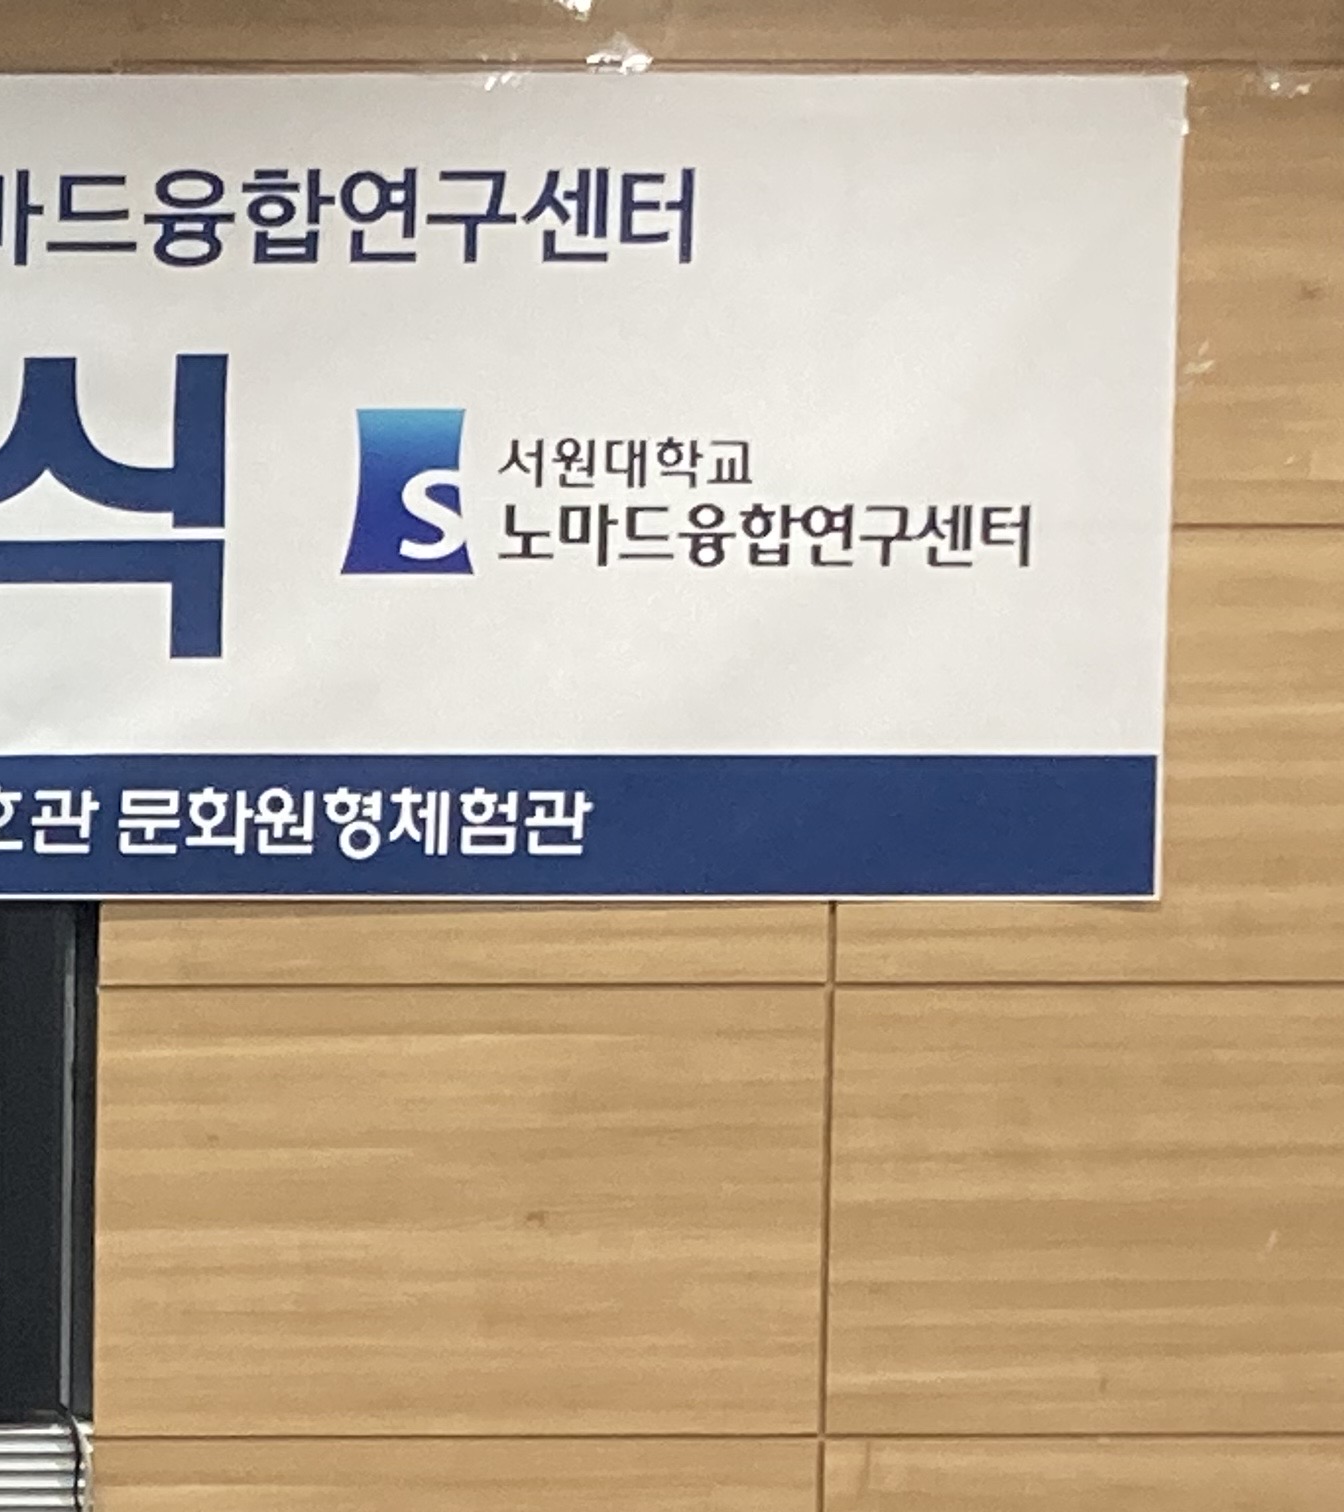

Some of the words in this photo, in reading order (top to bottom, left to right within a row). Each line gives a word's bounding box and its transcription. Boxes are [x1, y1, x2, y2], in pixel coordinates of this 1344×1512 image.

[498, 437, 753, 489] 서원대학교
[498, 503, 1032, 568] 노마드융합연구센터
[117, 785, 593, 861] 문화원형체험관
